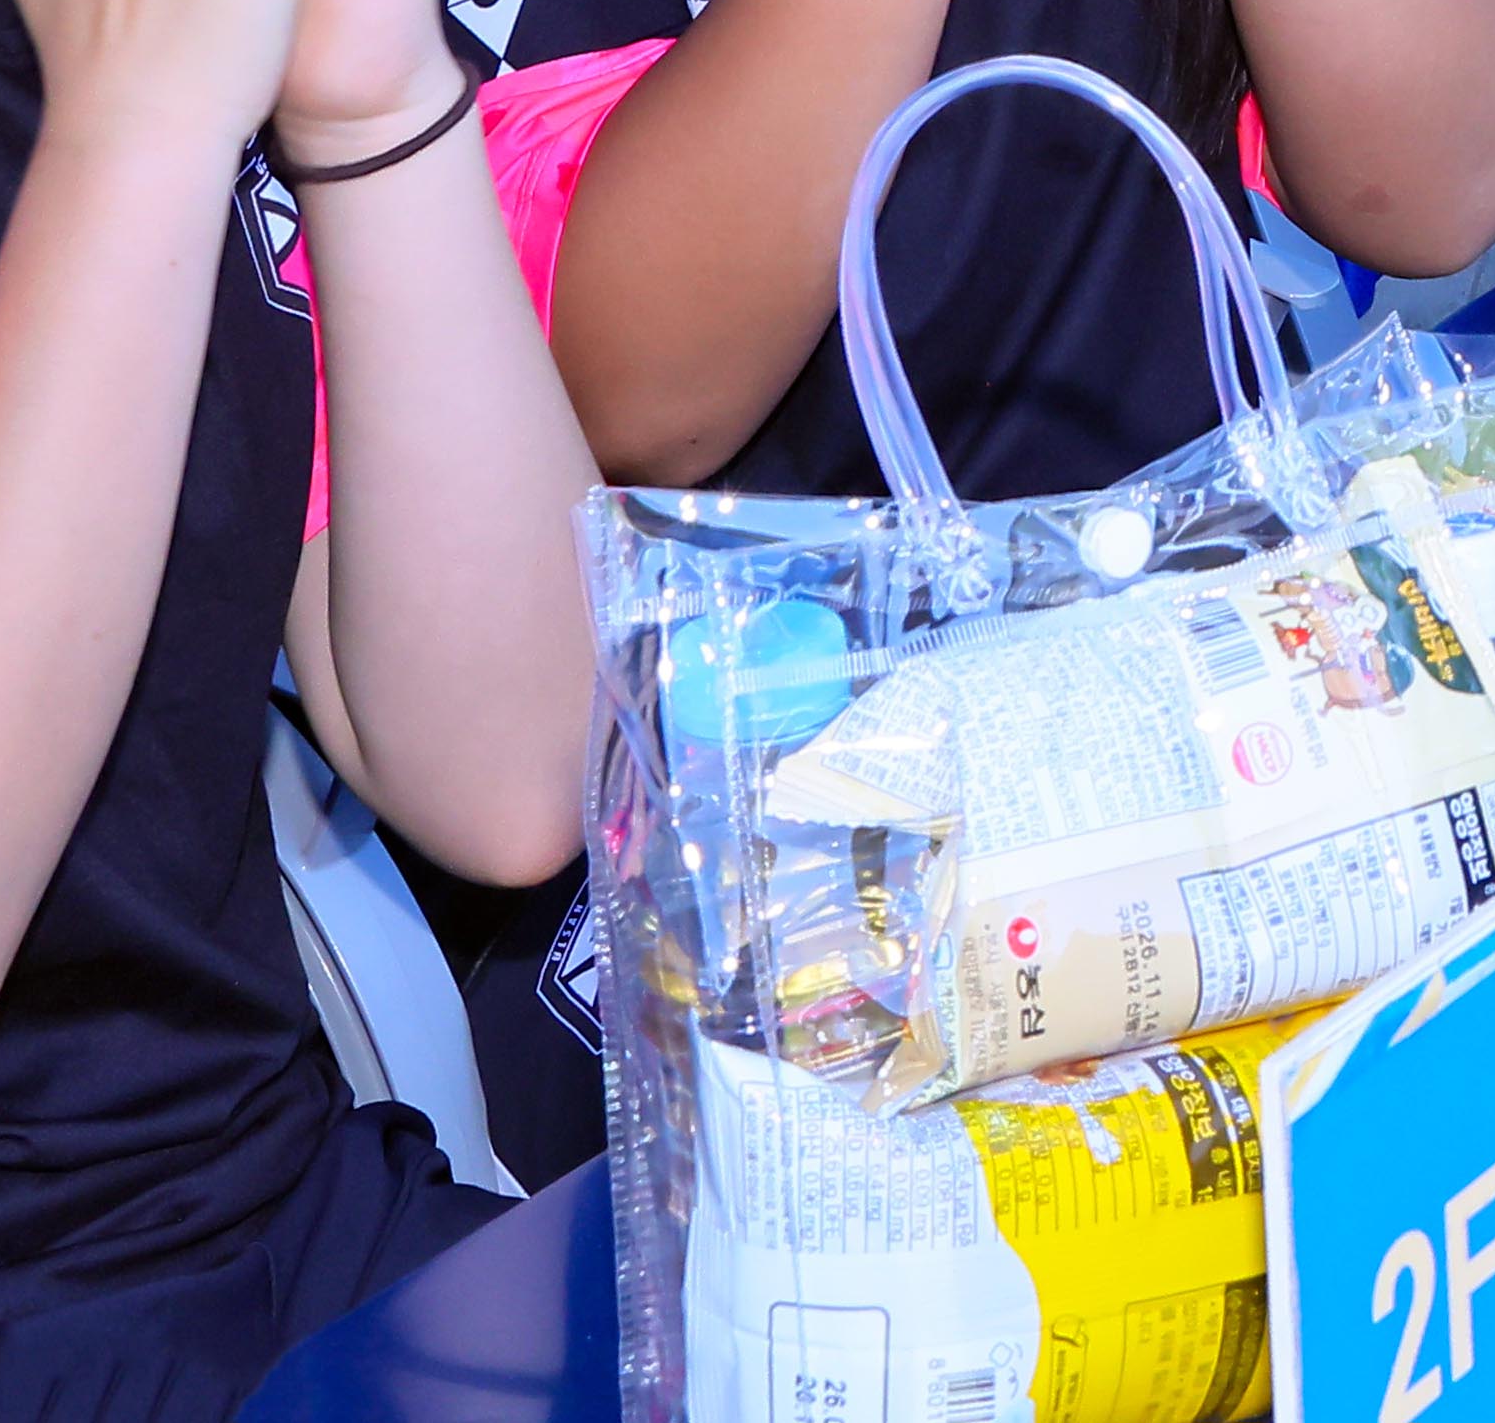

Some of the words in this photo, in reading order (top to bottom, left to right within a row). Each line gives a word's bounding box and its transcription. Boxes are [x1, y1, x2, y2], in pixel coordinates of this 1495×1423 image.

[1320, 842, 1335, 867] 지방
[1341, 847, 1359, 871] 당류
[1357, 829, 1381, 880] 탄수화물
[1448, 791, 1495, 883] 영양정보
[1249, 866, 1282, 926] 콜레스테롤
[1279, 870, 1304, 919] 포화지방
[552, 904, 584, 963] ULSAN
[1132, 900, 1159, 1034] 2026.11.14
[1016, 965, 1045, 1039] 농심
[1158, 1058, 1216, 1142] 영양정보
